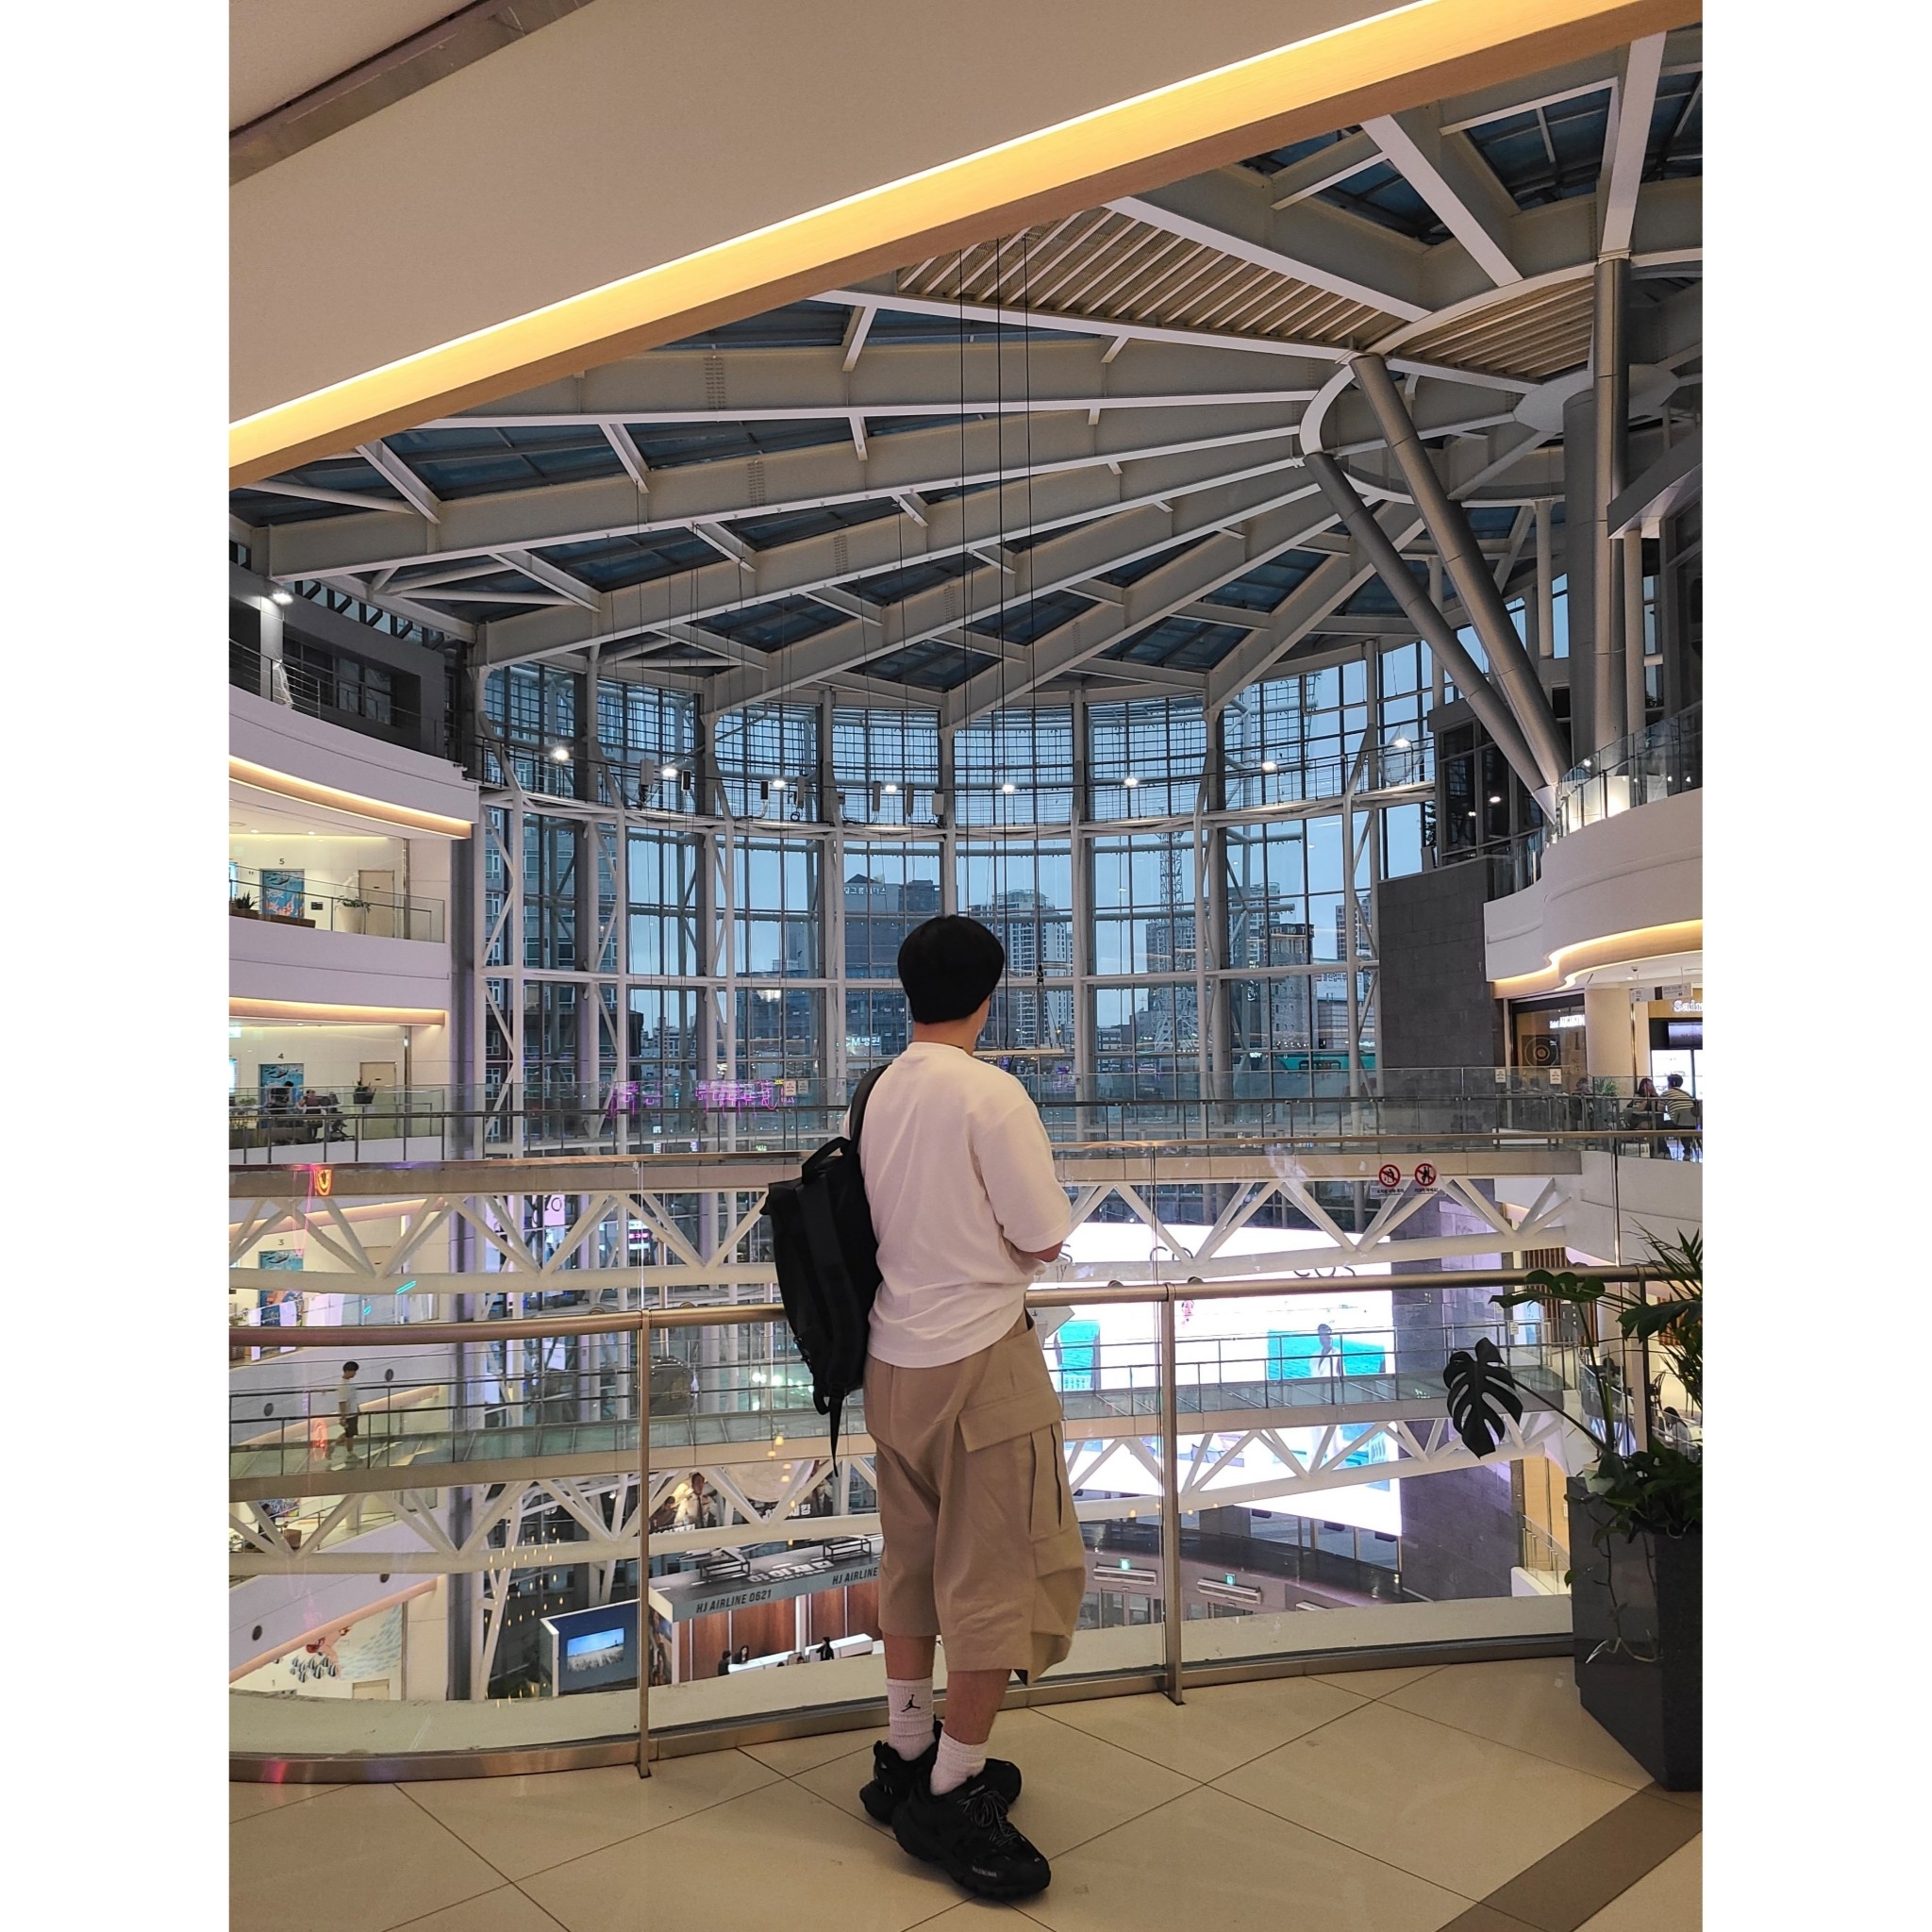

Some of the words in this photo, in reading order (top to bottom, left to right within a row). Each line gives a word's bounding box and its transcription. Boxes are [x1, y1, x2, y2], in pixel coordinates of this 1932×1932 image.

[832, 1574, 843, 1585] HJ
[844, 1567, 878, 1583] AIRLINE
[696, 1602, 708, 1613] HJ
[709, 1594, 747, 1611] AIRLINE
[749, 1589, 772, 1602] 0621
